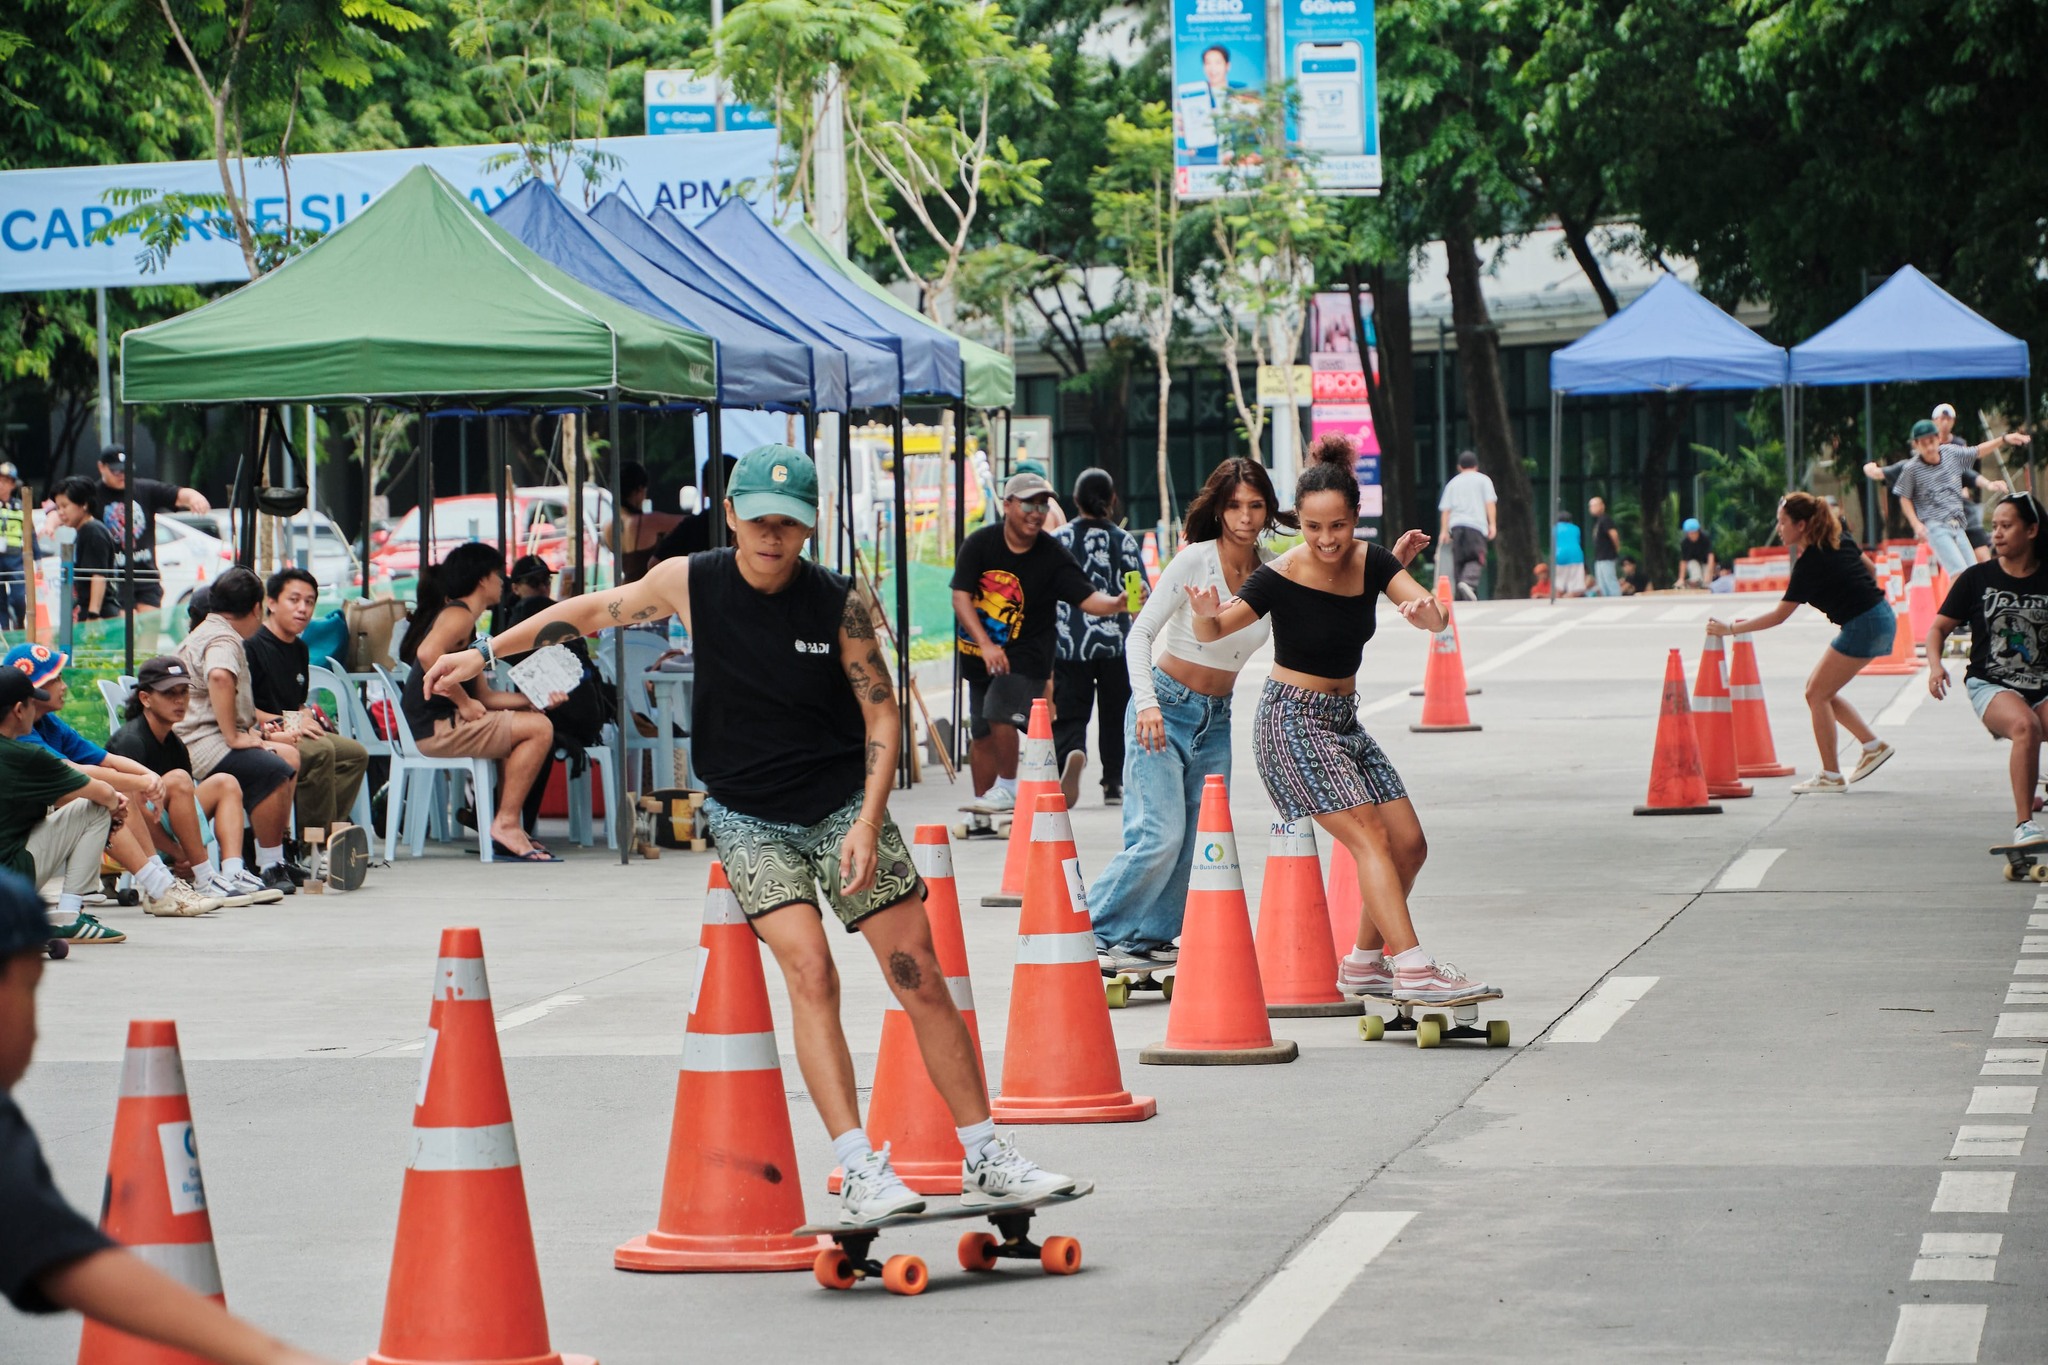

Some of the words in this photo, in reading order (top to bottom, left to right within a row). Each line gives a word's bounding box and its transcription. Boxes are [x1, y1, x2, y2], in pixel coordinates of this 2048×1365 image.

[1, 196, 286, 252] CAR-RE
[772, 464, 788, 482] C
[1270, 822, 1296, 835] PMC
[1199, 863, 1229, 871] Business
